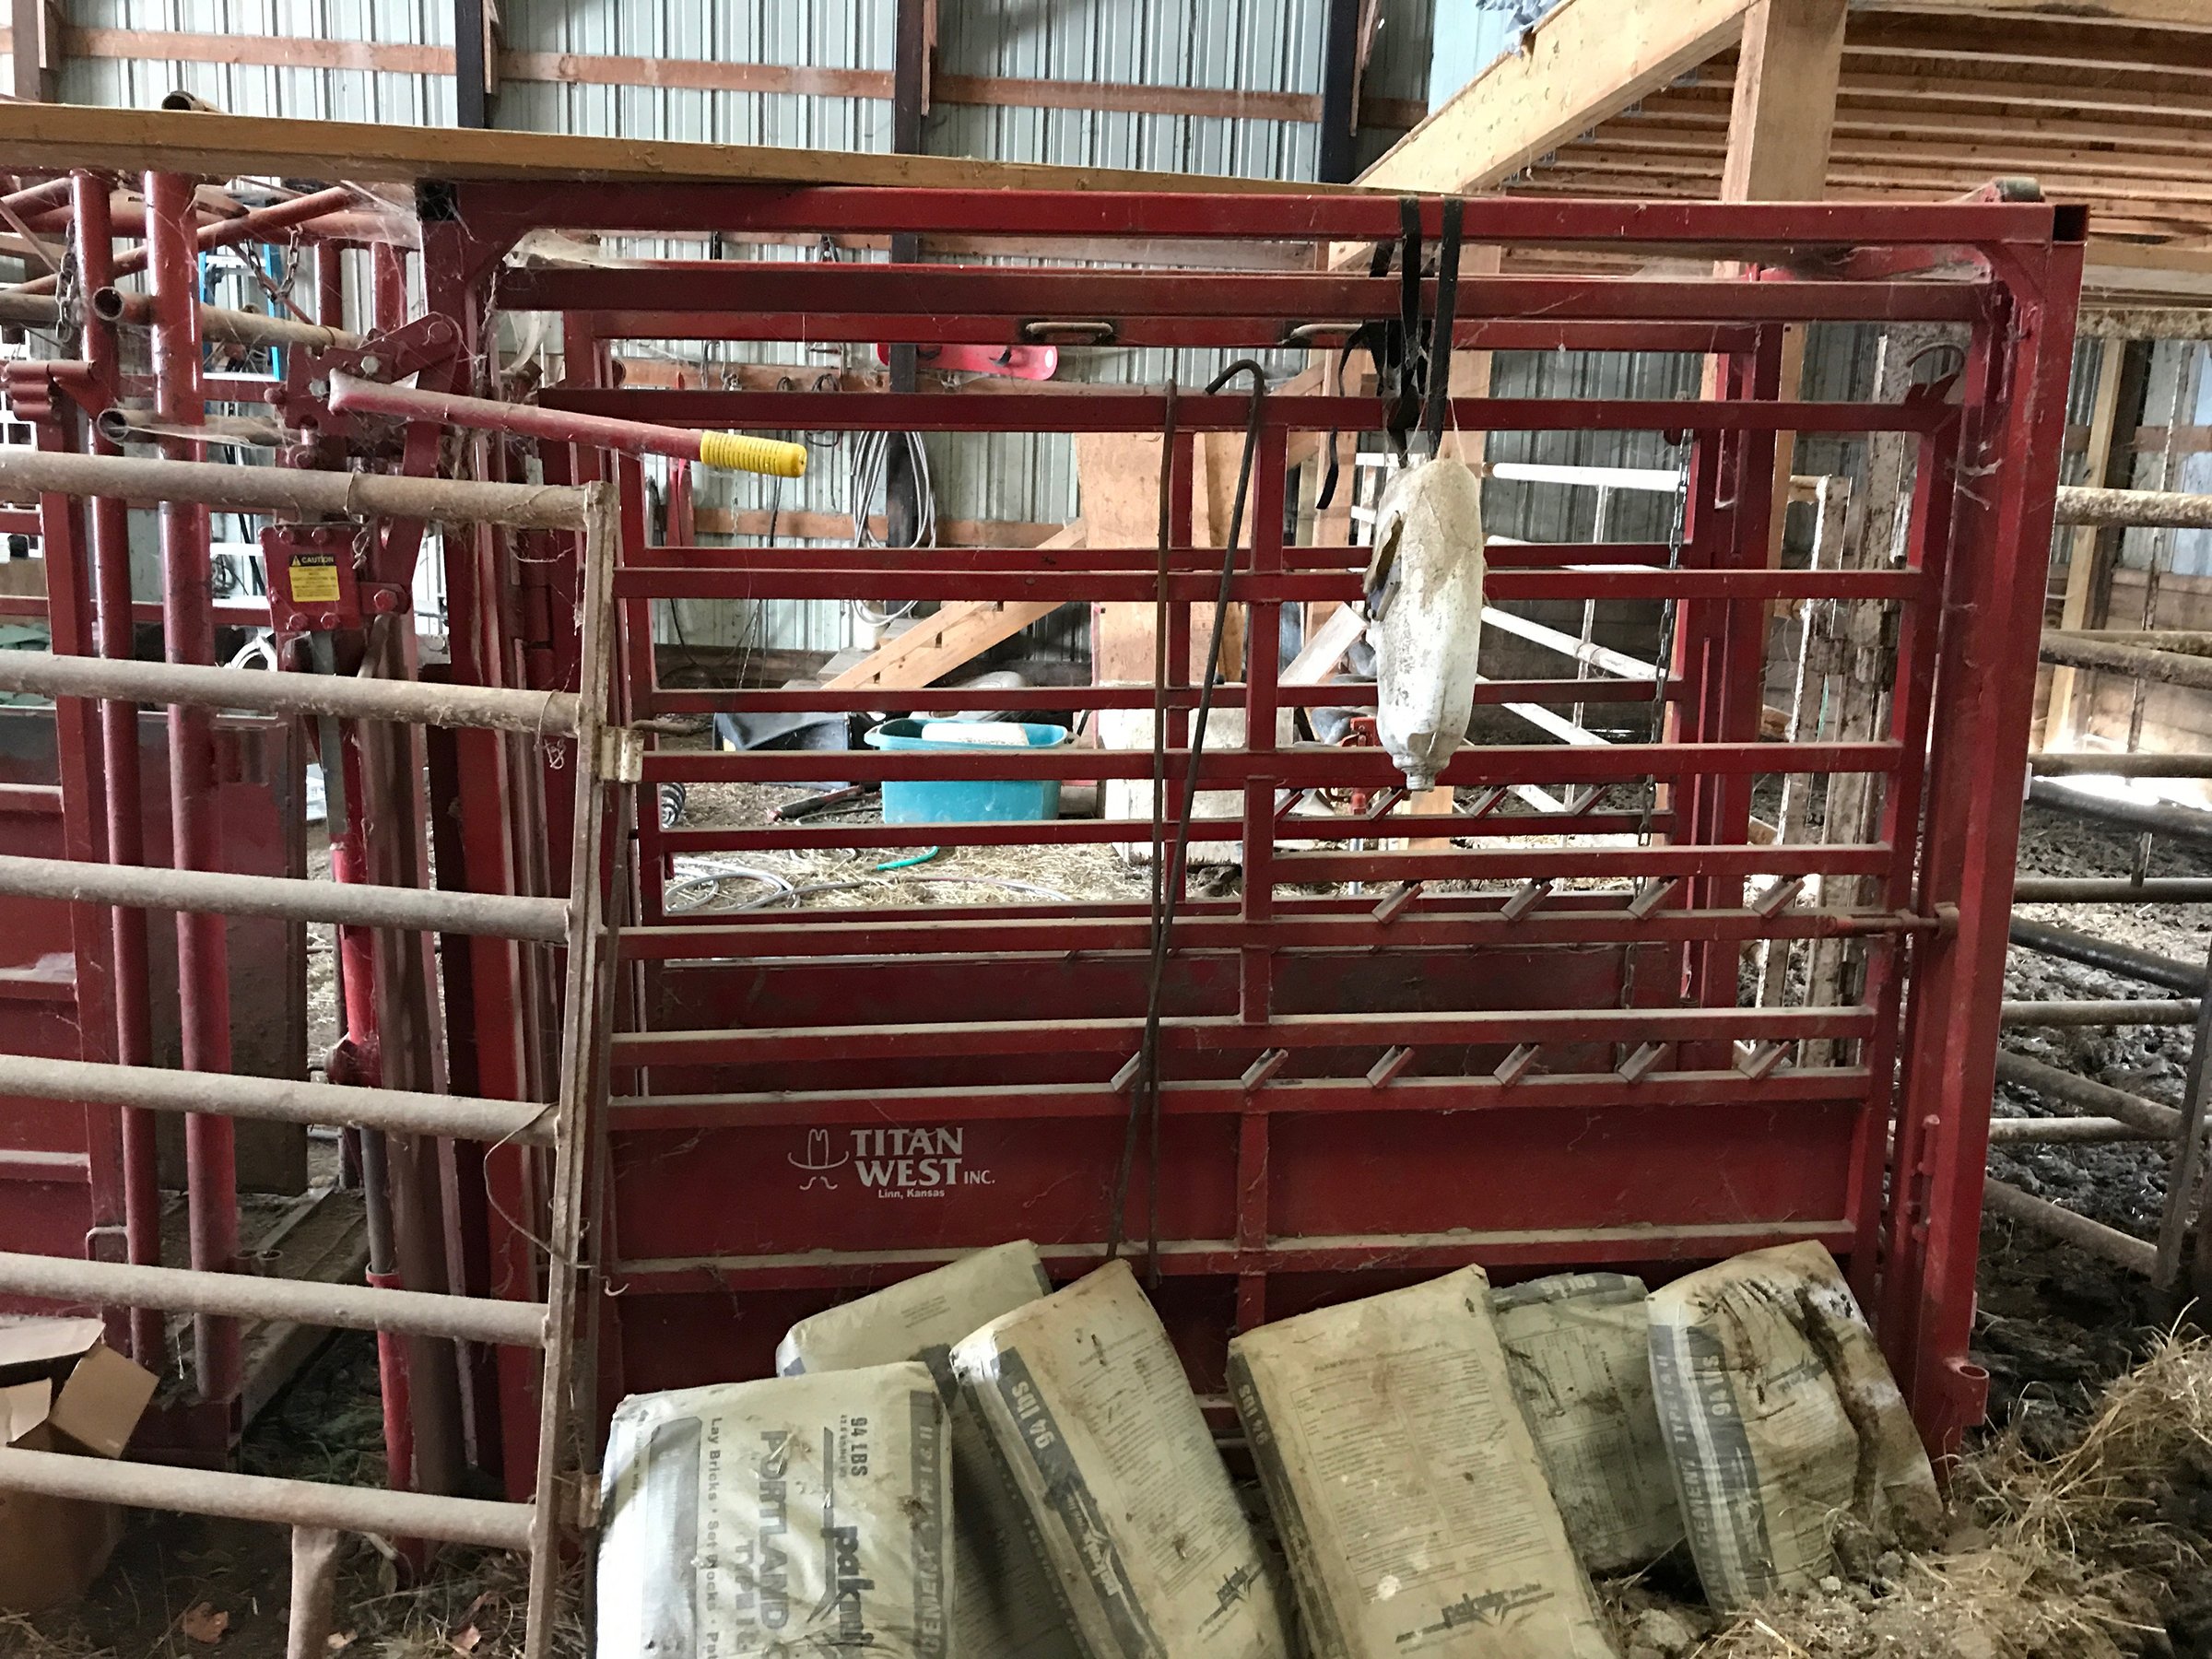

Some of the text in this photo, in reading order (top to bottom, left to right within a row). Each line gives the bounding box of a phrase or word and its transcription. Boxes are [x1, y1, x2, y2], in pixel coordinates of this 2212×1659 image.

[851, 1127, 963, 1157] TITAN
[854, 1159, 996, 1188] WEST INC.
[878, 1187, 945, 1199] Linn, Kansas
[1011, 1381, 1056, 1450] 94 lbs
[1239, 1384, 1269, 1445] 94 lbs
[1668, 1402, 1688, 1443] TYPE
[1709, 1390, 1733, 1417] 94
[708, 1417, 723, 1444] Lay
[851, 1417, 868, 1477] 94 LBS
[708, 1450, 722, 1501] Bricks
[1680, 1455, 1711, 1549] CEMENT
[707, 1520, 720, 1548] Set
[759, 1430, 789, 1630] PORTLAND
[706, 1553, 719, 1612] Bocks
[735, 1539, 754, 1609] TYPE
